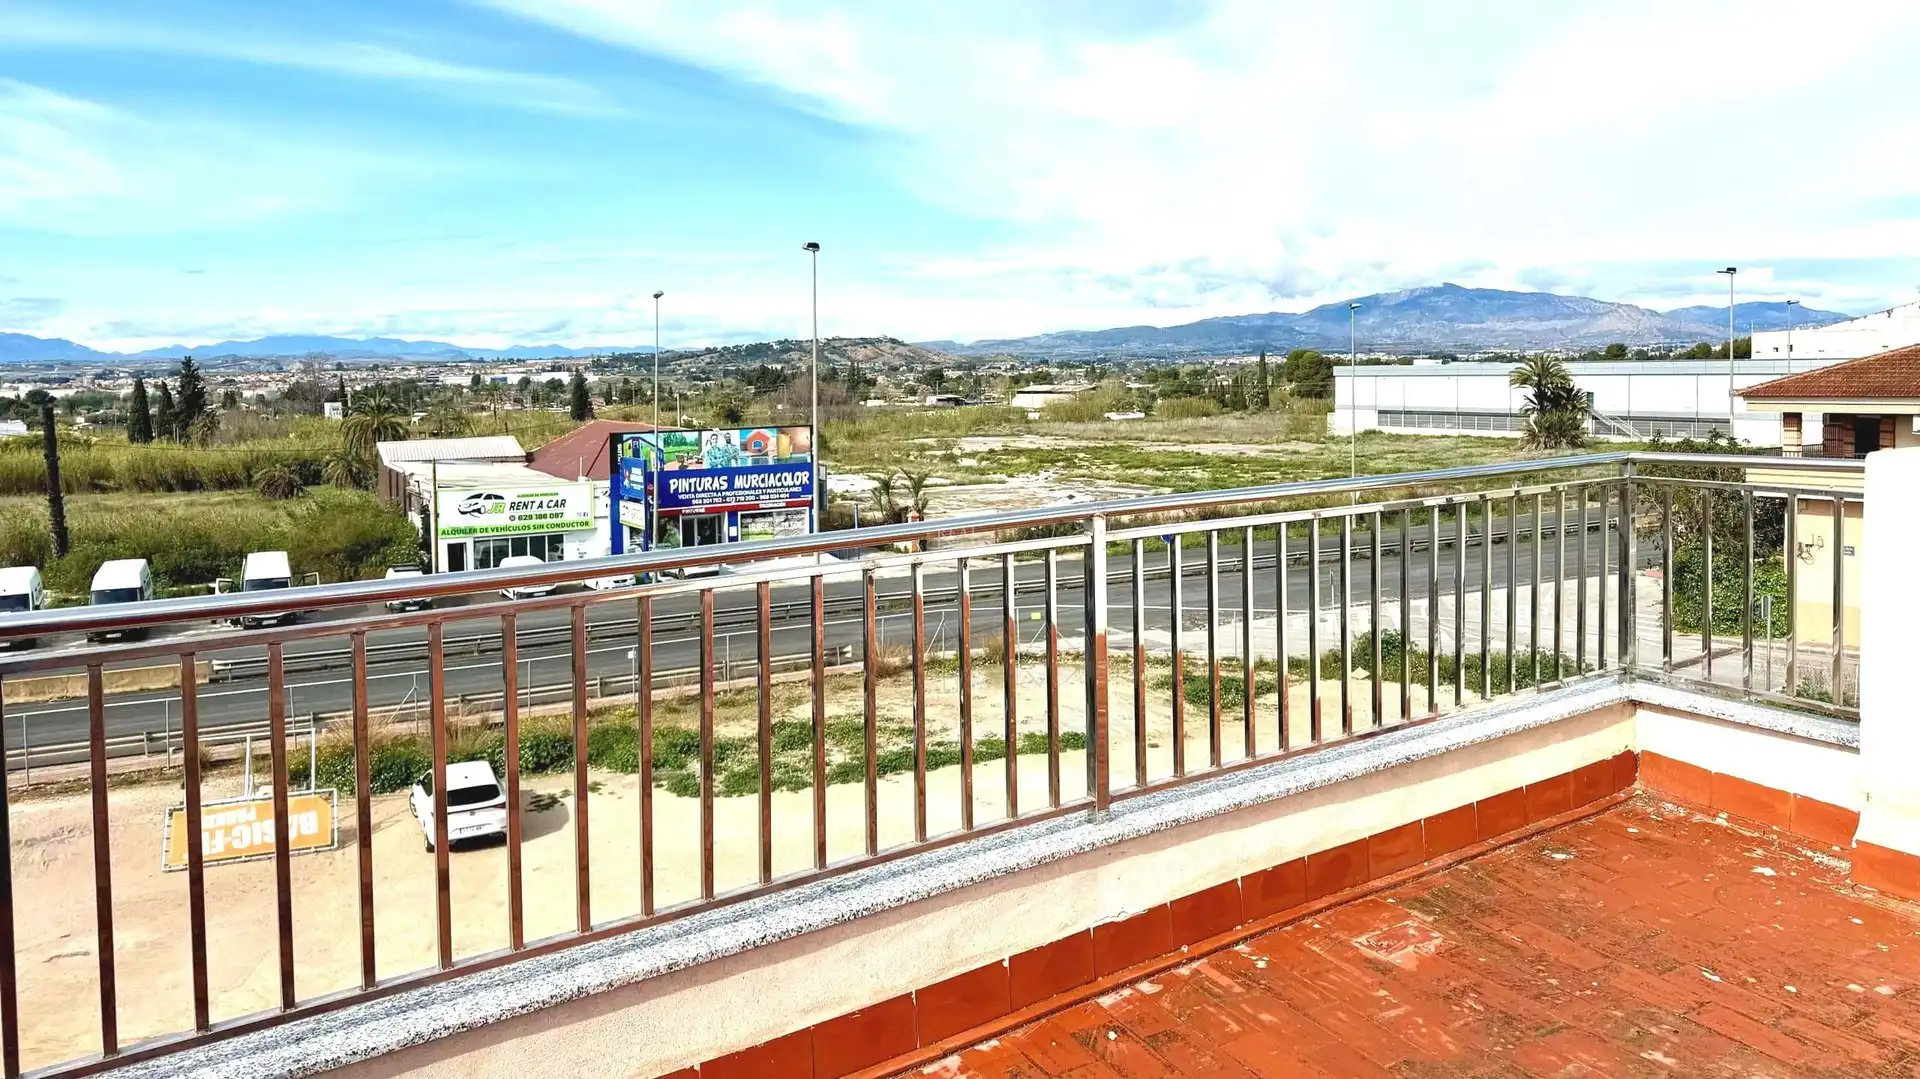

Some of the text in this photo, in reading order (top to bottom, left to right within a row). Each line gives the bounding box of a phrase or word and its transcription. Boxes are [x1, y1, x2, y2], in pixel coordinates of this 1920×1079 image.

[669, 471, 810, 494] PINTURAS MURCIACOLOR
[695, 491, 717, 499] DIRECTA
[767, 486, 802, 494] PARTICULARES
[509, 499, 567, 511] RENT A CAR
[441, 527, 478, 536] ALQUILER
[490, 524, 531, 533] VEHÍCULOS
[546, 521, 590, 529] CONDUCTOR
